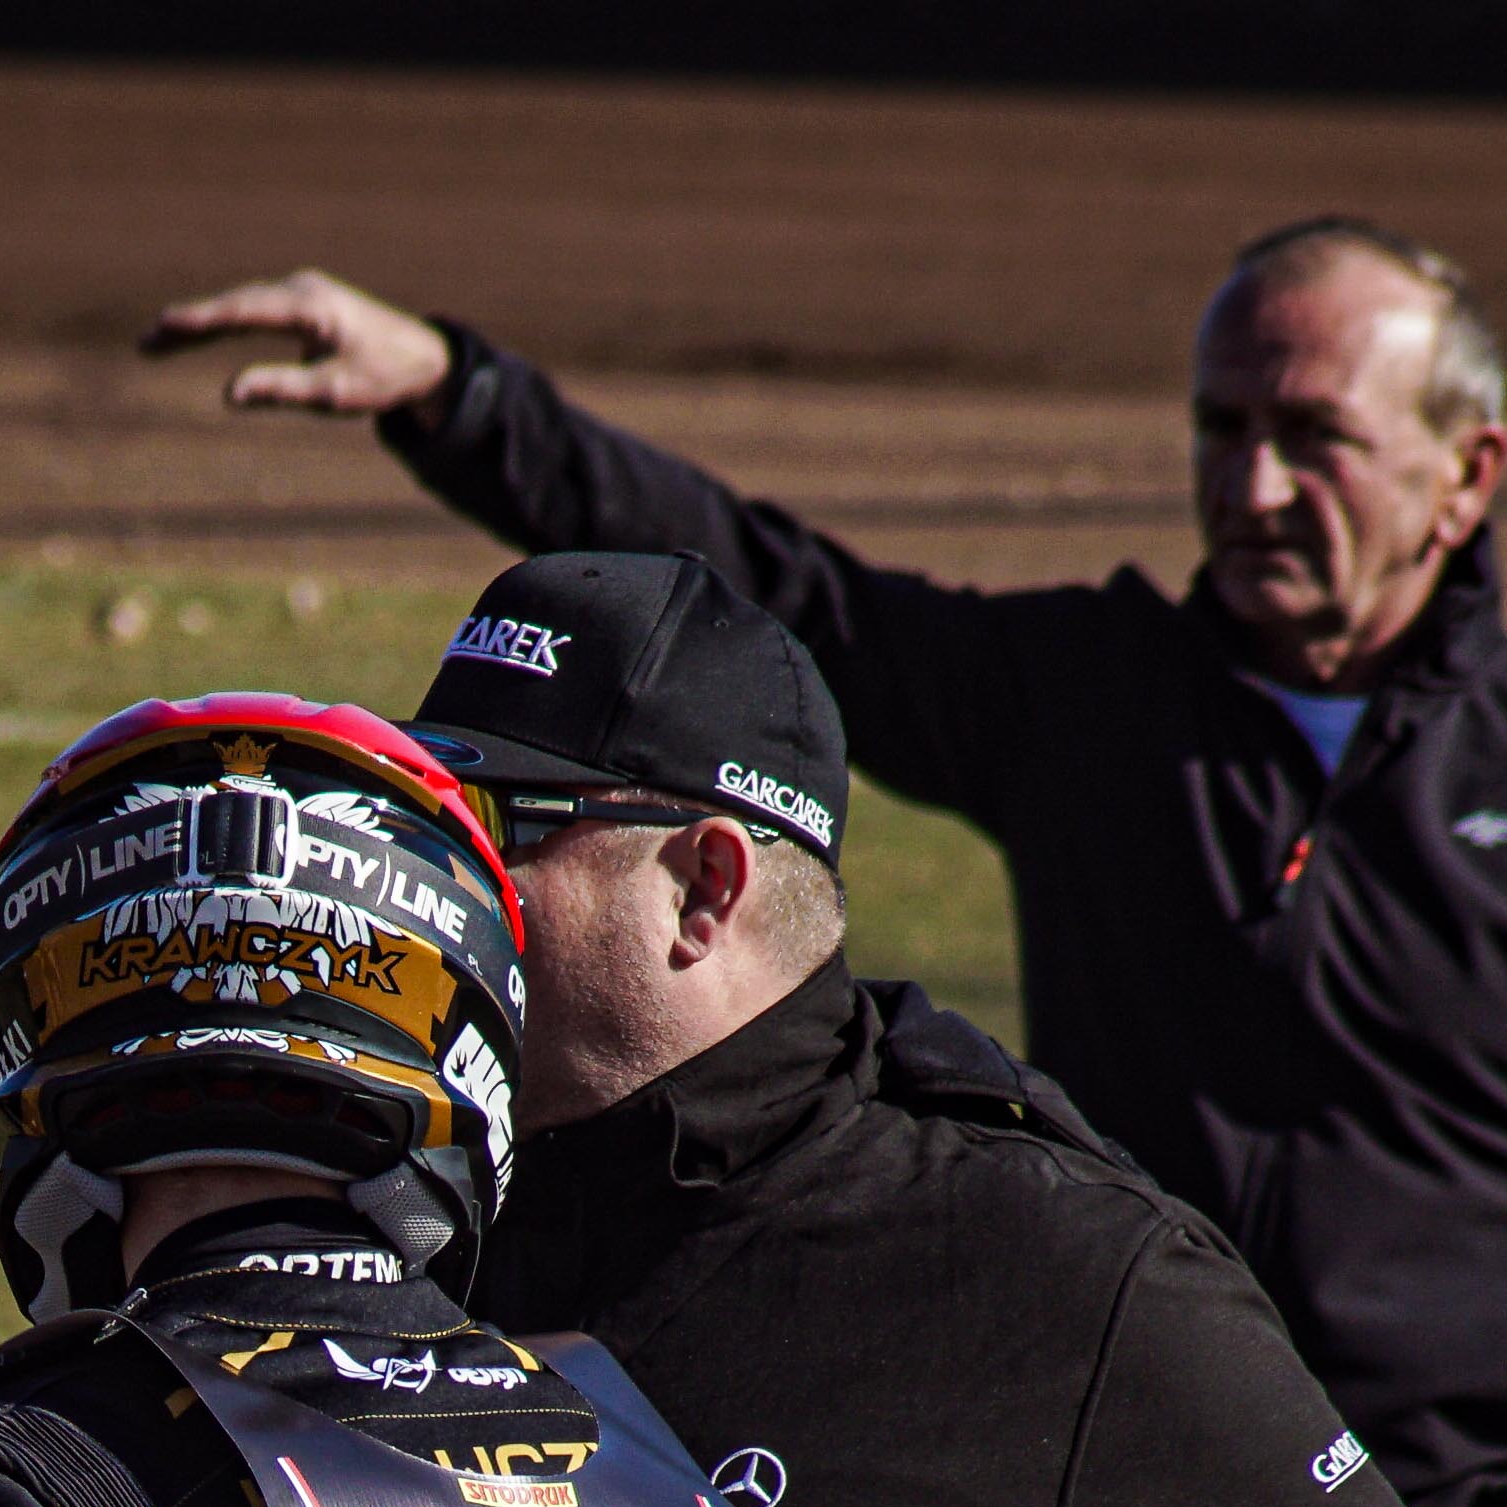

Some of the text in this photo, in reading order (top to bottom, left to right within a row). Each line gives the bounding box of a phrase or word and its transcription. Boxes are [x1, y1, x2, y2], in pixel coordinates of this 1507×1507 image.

[716, 761, 835, 848] GARCAREK
[78, 921, 410, 997] KRAWCZYK
[464, 1481, 574, 1507] SITODRUK
